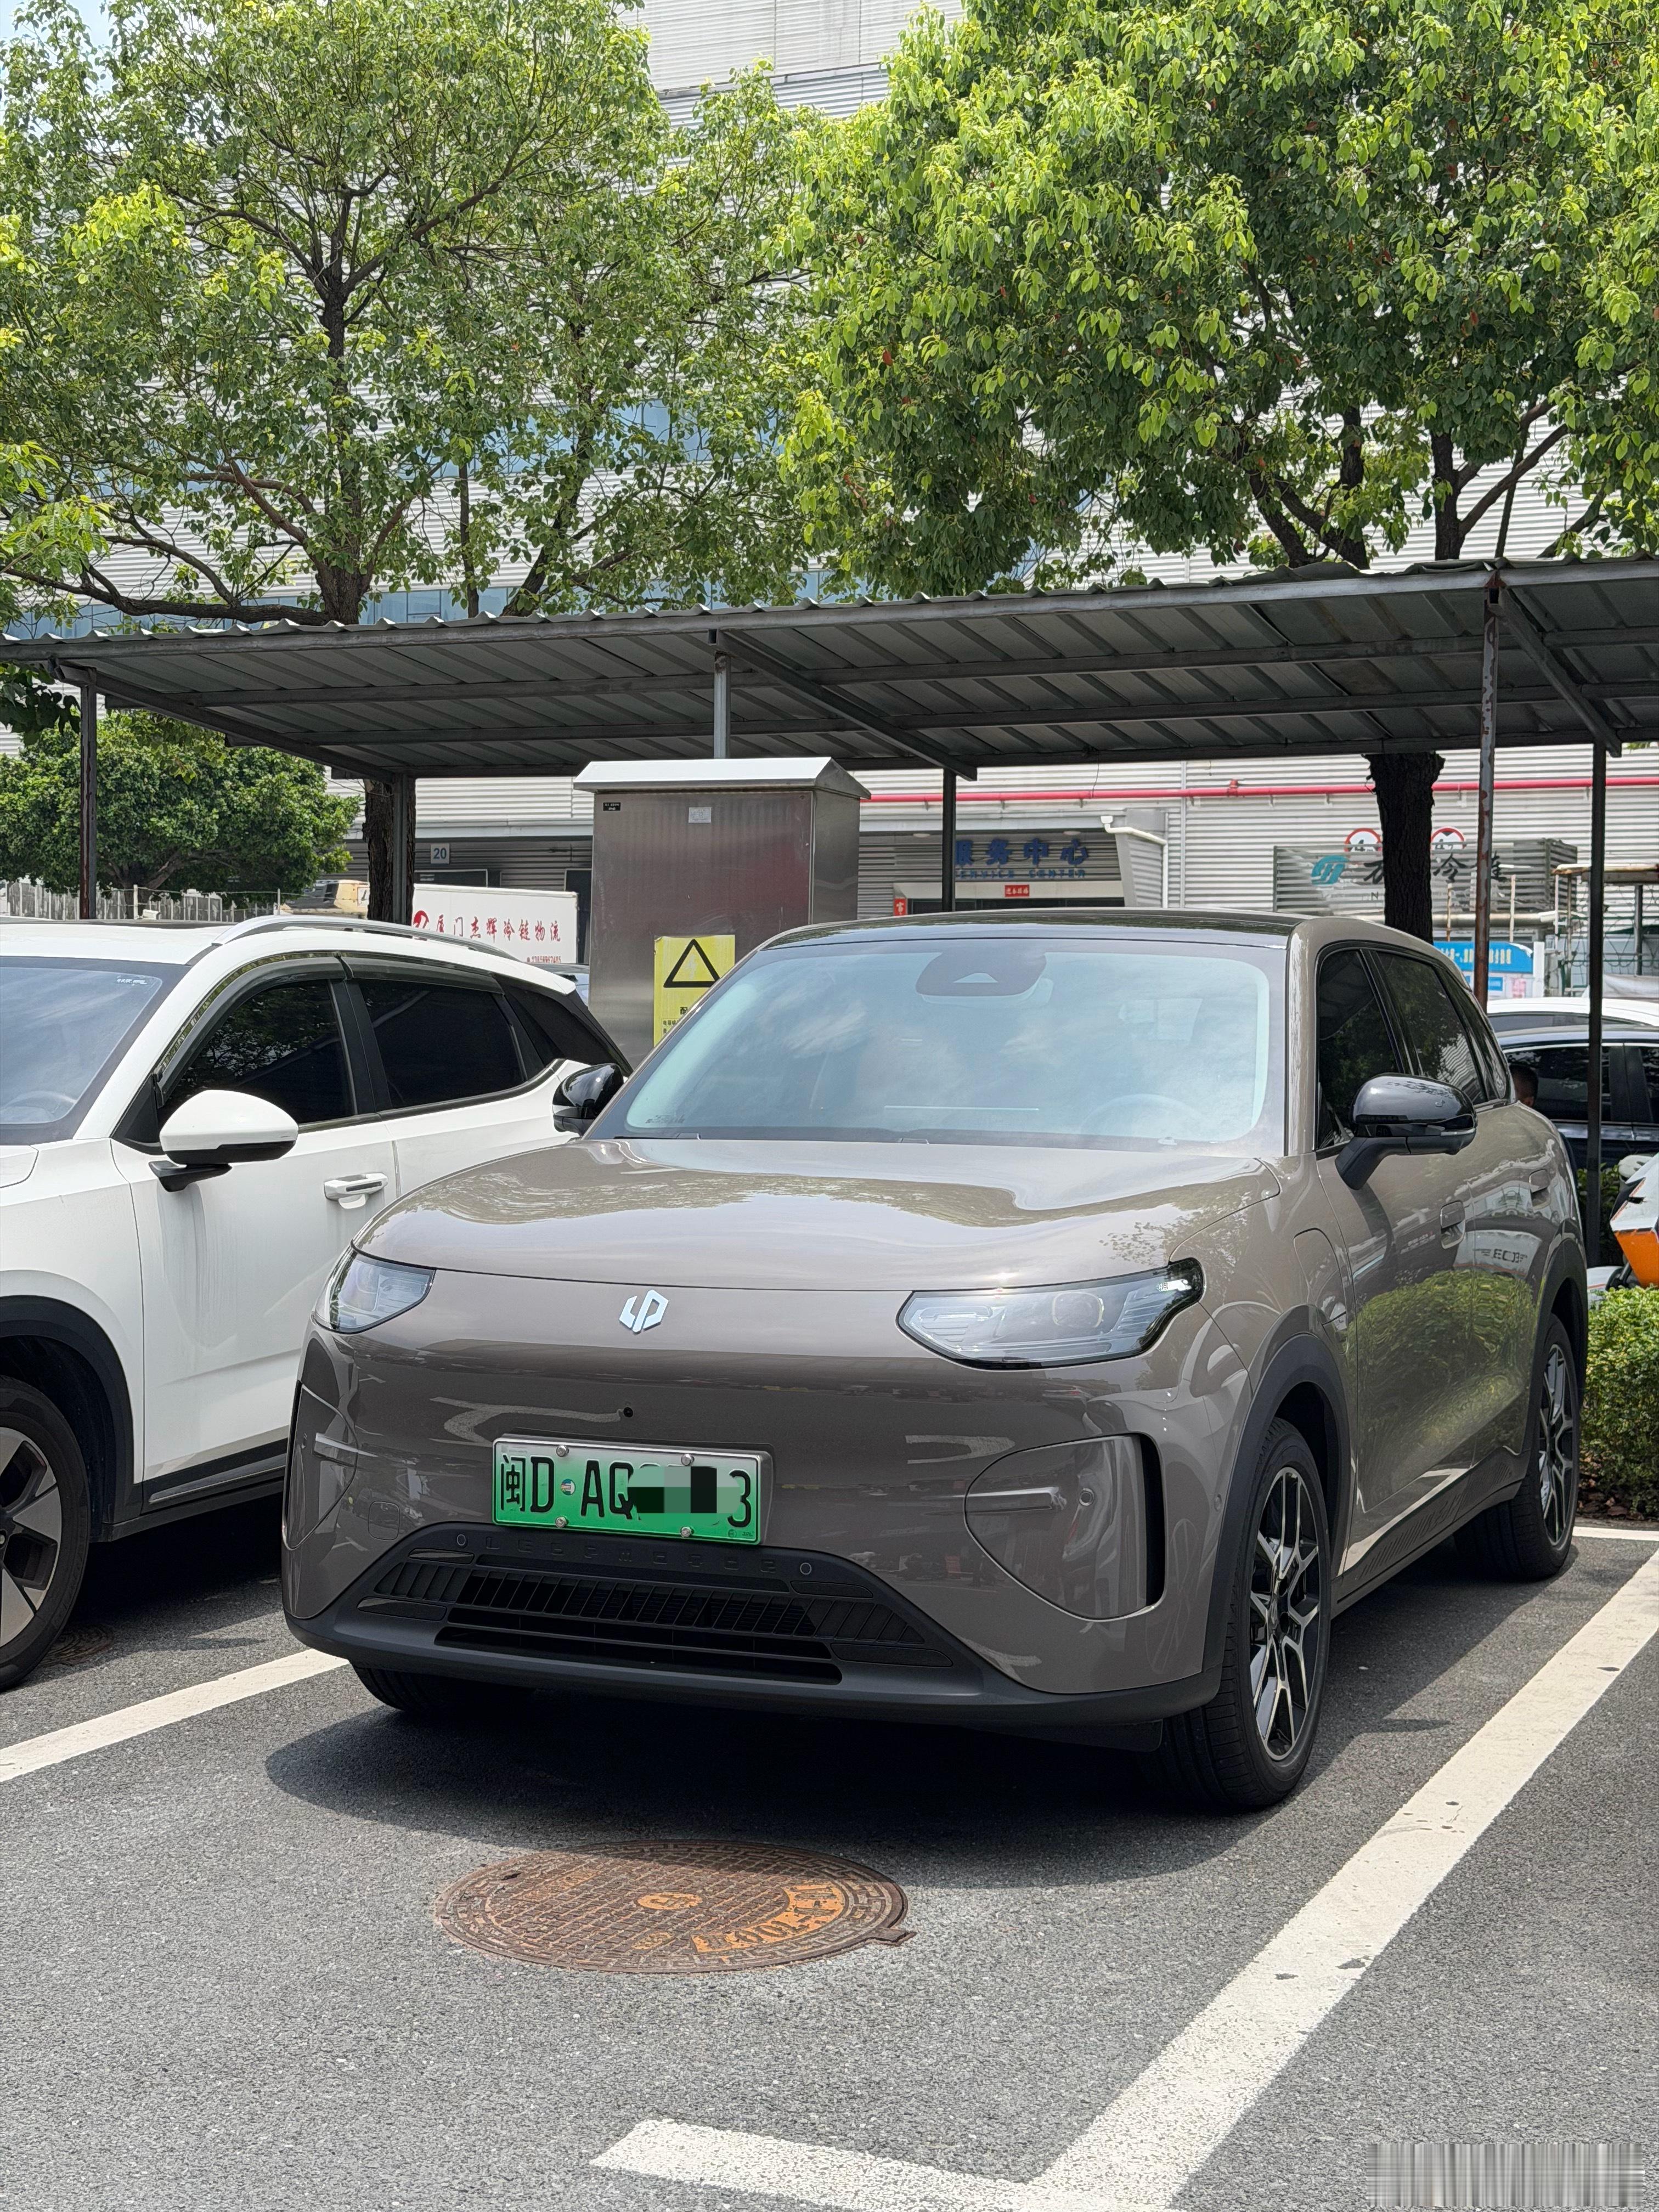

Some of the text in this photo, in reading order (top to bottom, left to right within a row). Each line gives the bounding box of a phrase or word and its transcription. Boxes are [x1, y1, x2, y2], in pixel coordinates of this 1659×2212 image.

[433, 848, 447, 859] 20
[955, 838, 1089, 865] 服务中心
[955, 869, 1086, 878] ERVICE CENTER
[580, 1459, 752, 1528] AQ3
